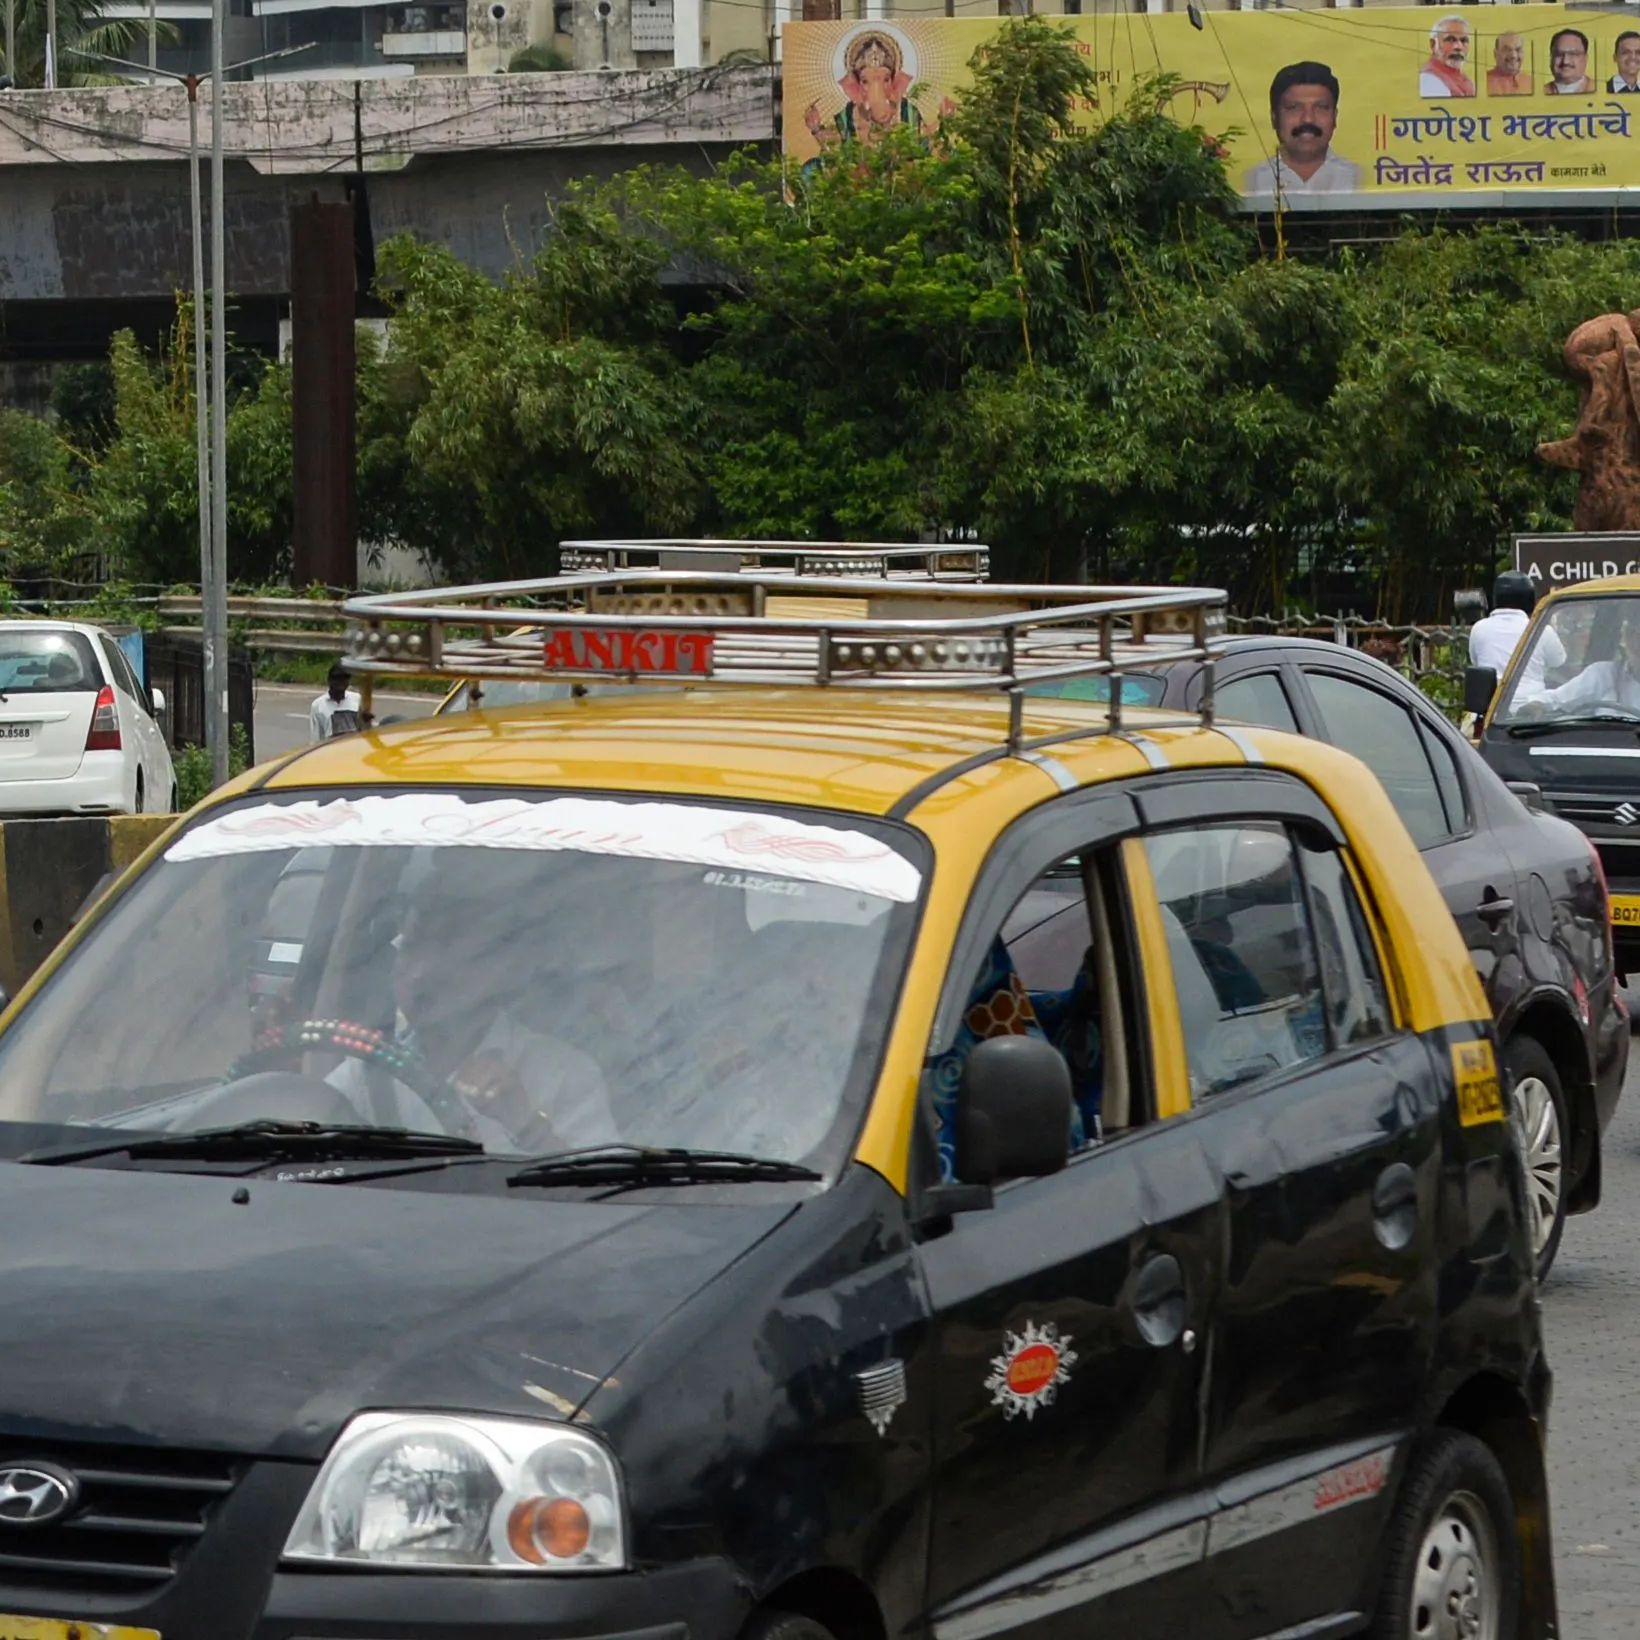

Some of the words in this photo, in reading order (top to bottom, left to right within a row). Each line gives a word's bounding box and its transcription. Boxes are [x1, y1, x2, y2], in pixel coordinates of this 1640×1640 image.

[1391, 107, 1492, 143] गणेश
[1503, 102, 1632, 142] भक्तांचे
[1466, 161, 1546, 183] राऊत
[1528, 562, 1543, 580] A
[1550, 561, 1619, 581] CHILD
[545, 630, 714, 675] ANKIT
